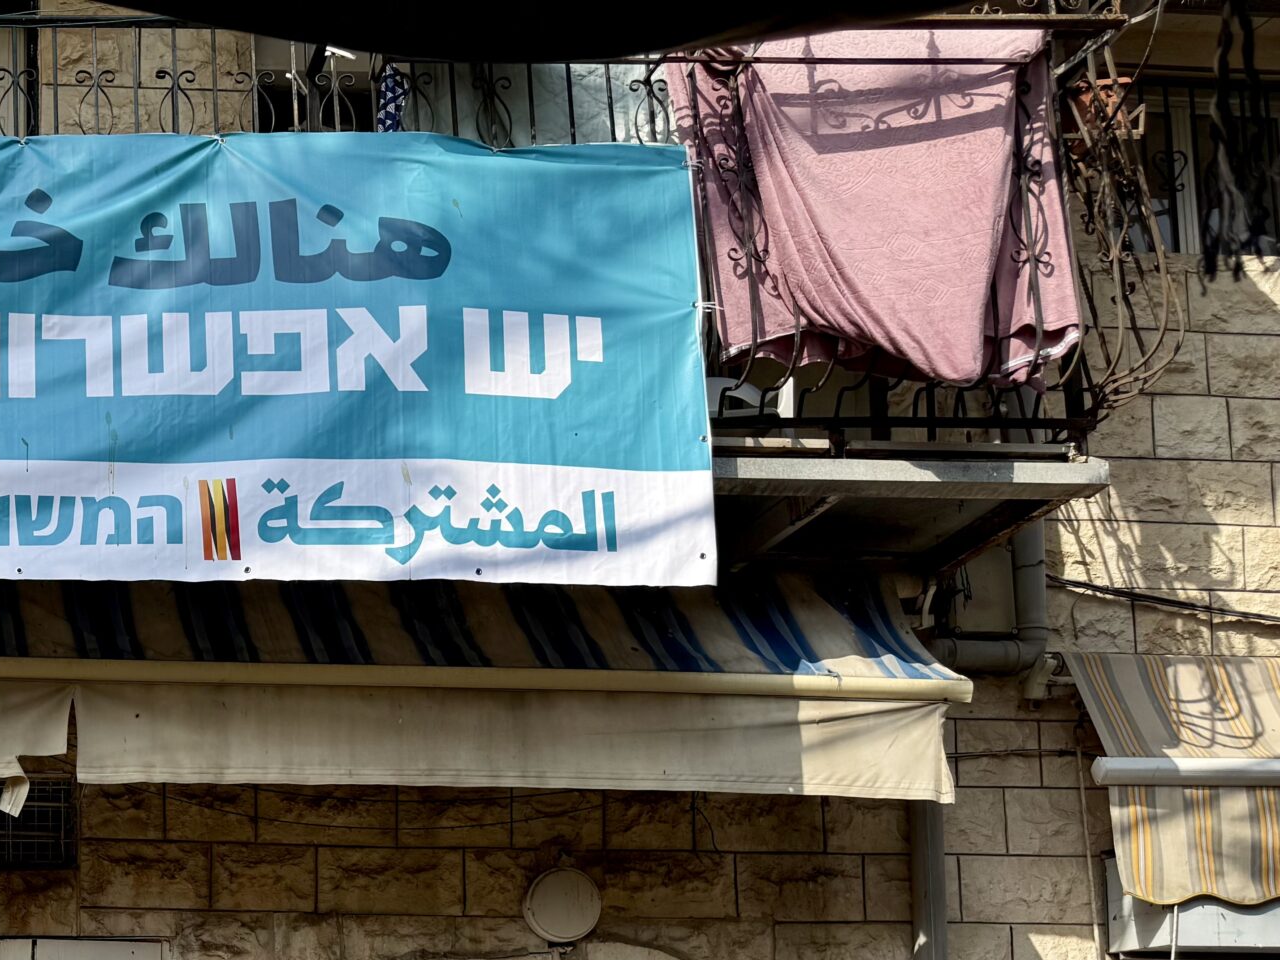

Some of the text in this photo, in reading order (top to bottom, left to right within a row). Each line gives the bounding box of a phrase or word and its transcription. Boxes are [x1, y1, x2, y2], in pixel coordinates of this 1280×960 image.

[108, 198, 452, 289] هنالك
[462, 306, 606, 400] יש
[257, 478, 618, 565] المشتركة
